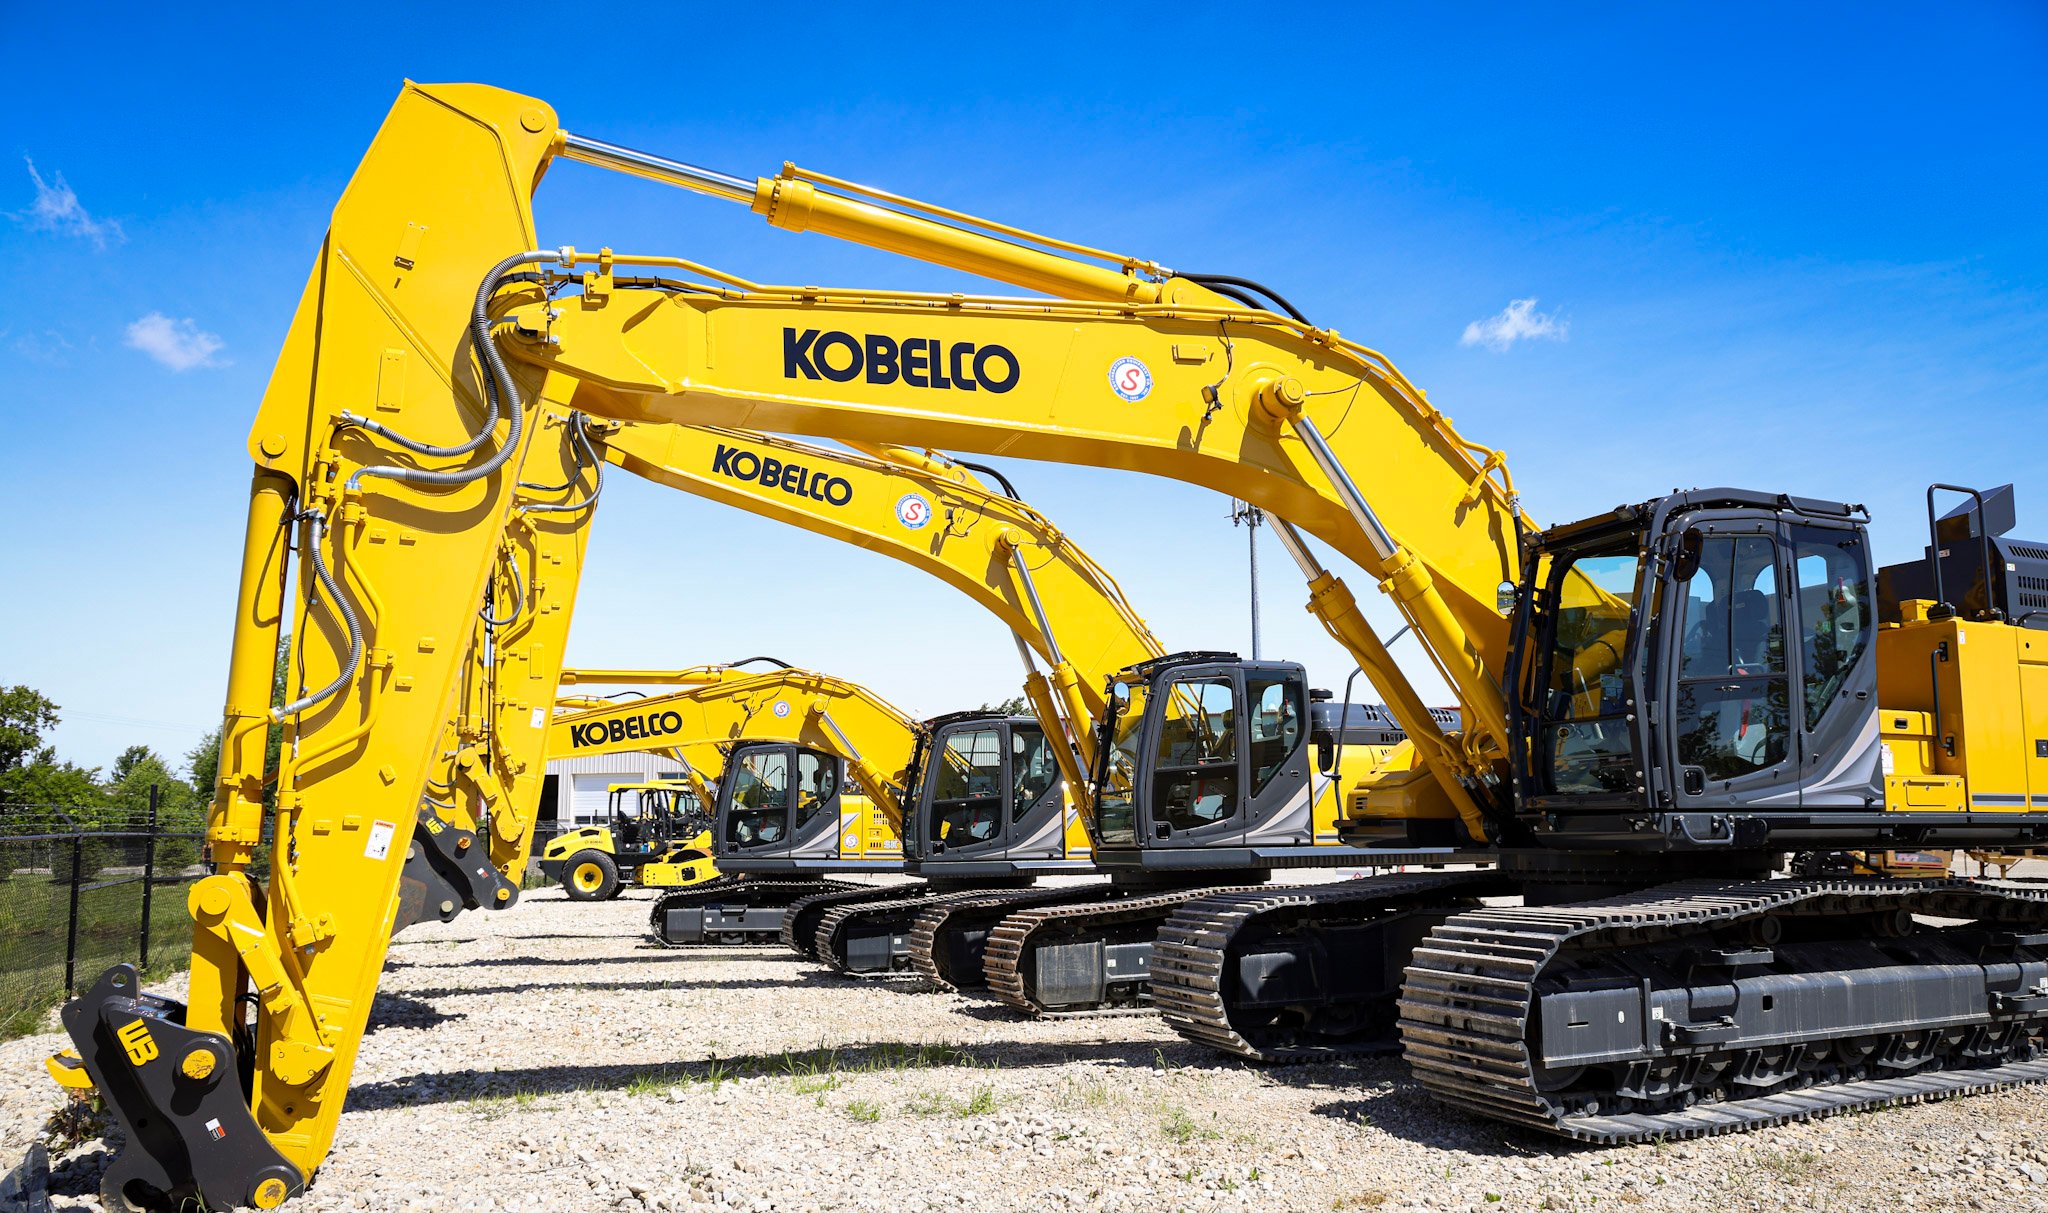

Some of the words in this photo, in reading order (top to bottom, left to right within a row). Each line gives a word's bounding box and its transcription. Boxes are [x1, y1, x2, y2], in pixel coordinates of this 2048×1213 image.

[783, 327, 1020, 394] KOBELCO
[1121, 368, 1139, 391] S
[712, 444, 853, 507] KOBELCO
[905, 503, 921, 521] S
[570, 711, 683, 748] KOBELCO
